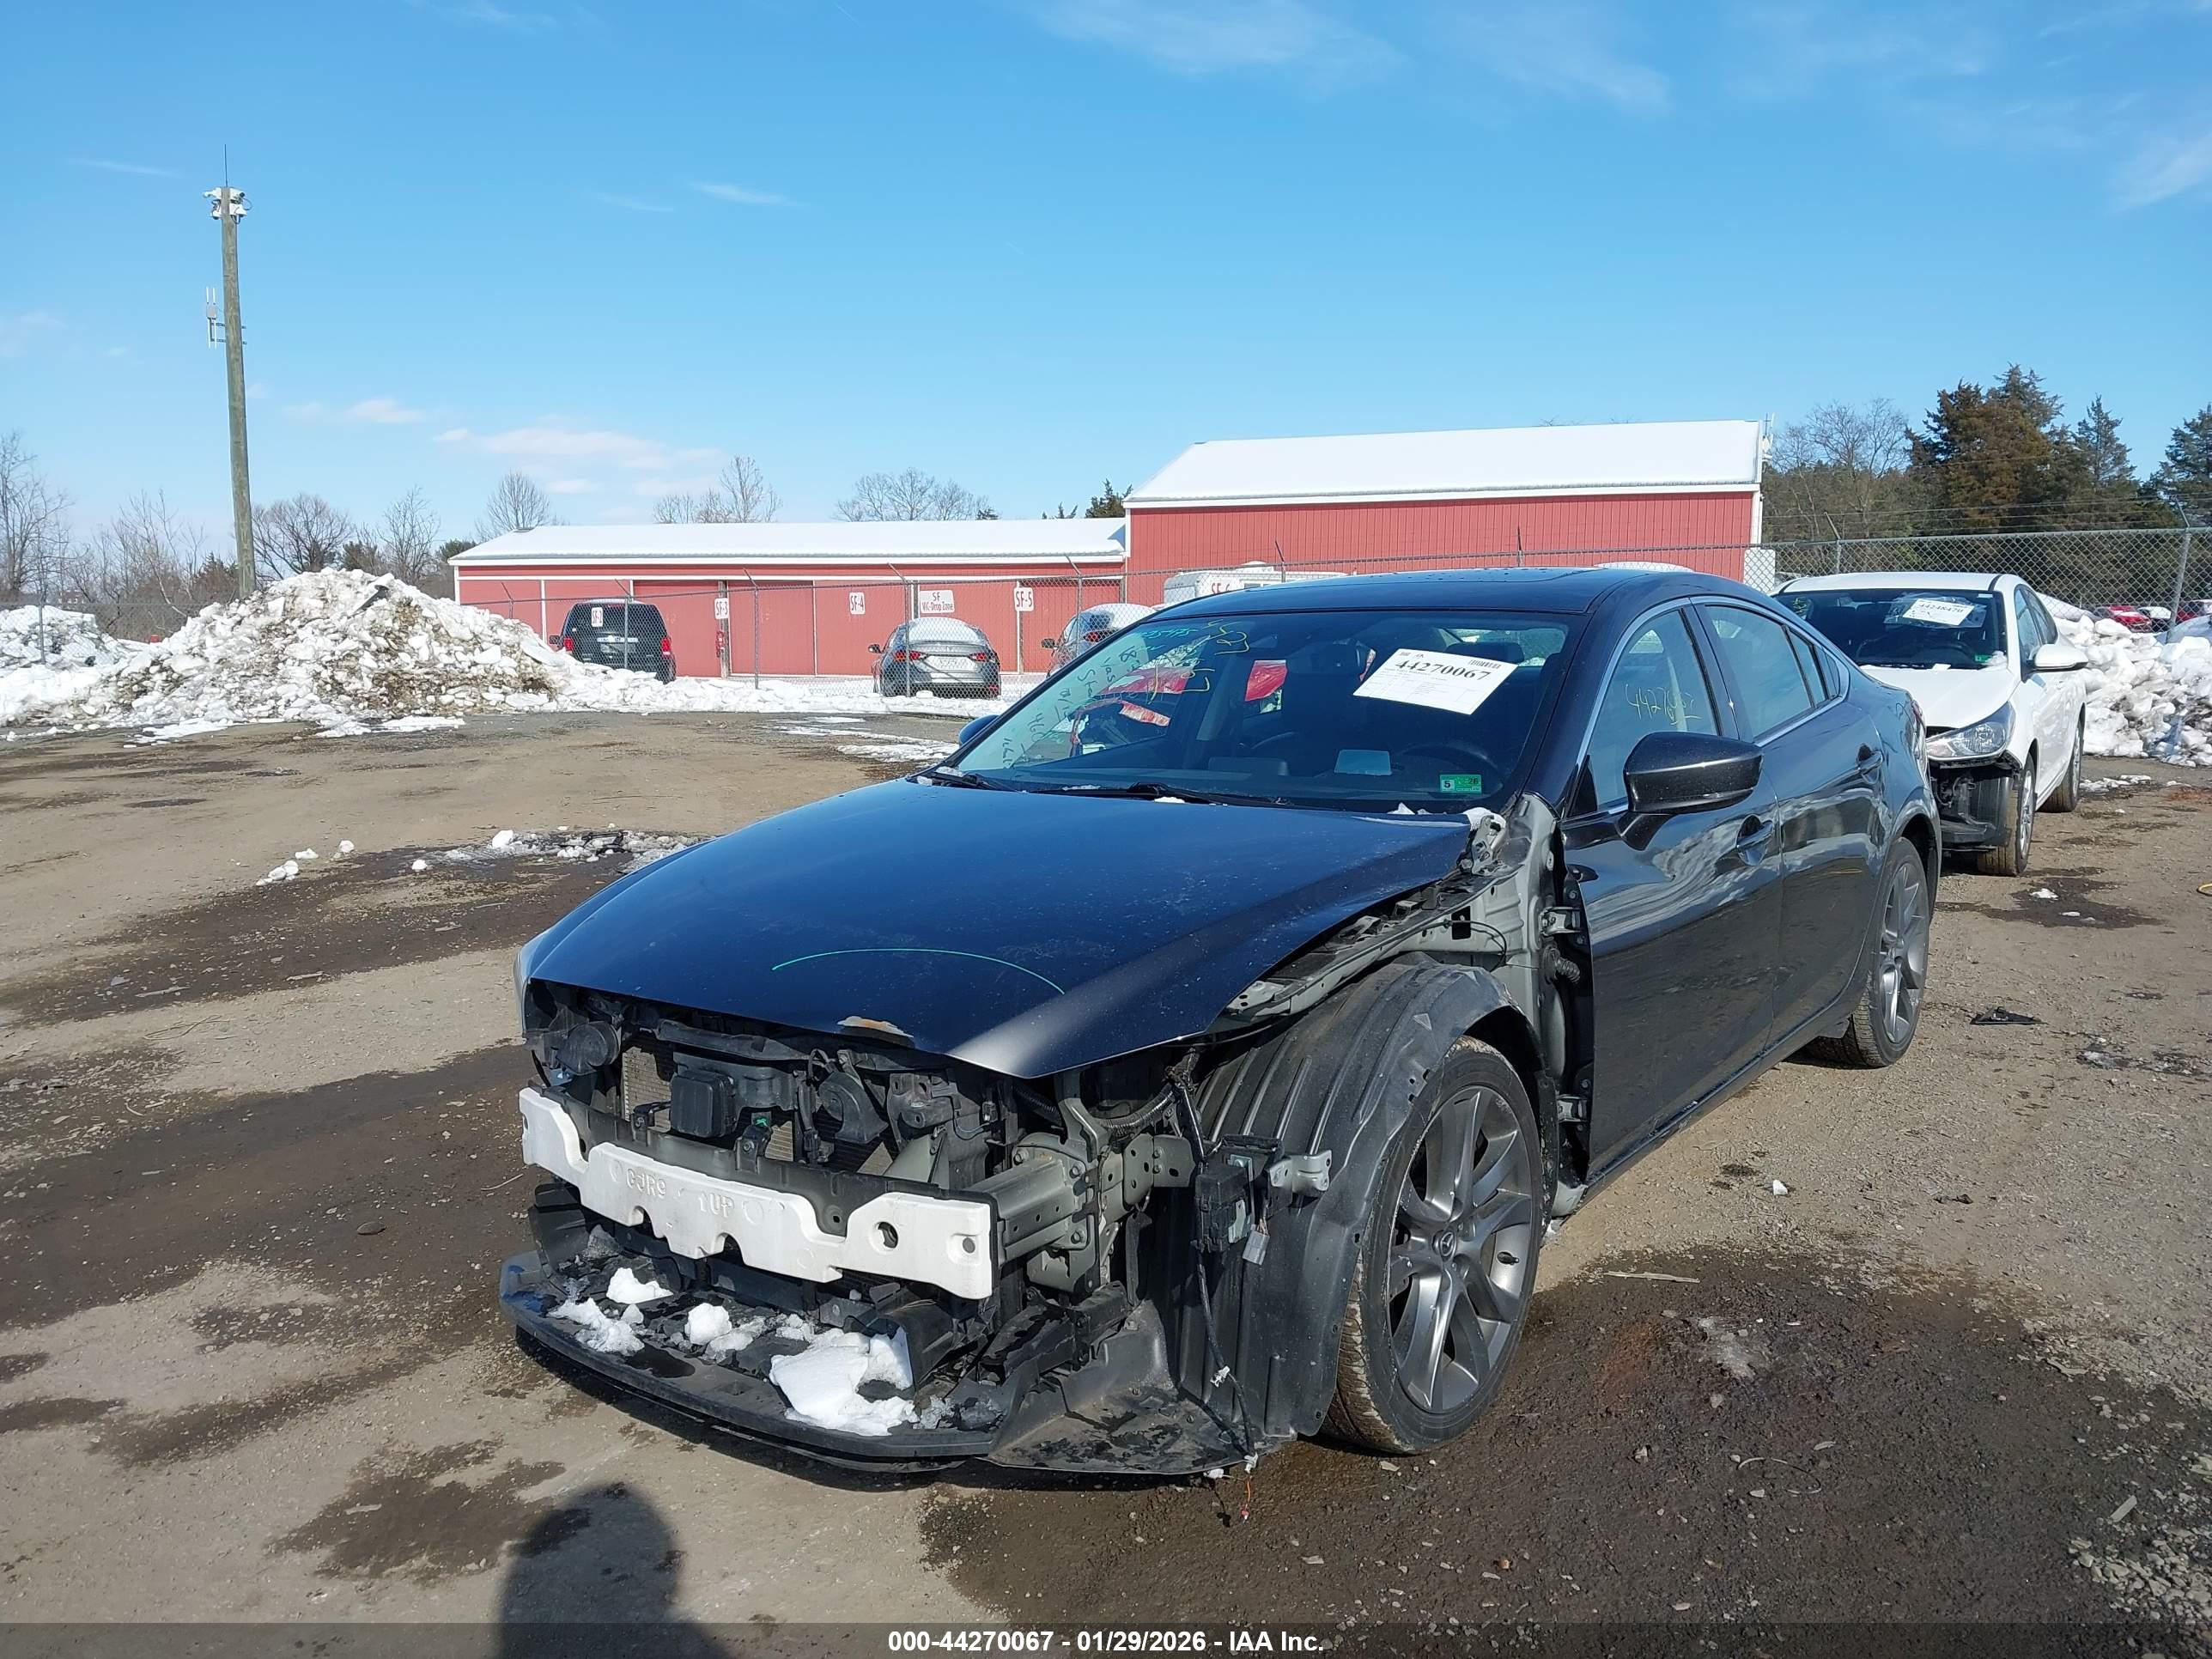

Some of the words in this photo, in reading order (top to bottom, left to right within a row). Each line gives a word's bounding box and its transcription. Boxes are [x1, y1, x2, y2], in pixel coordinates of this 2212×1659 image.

[850, 594, 865, 611] SF-4
[932, 592, 941, 602] SF
[1015, 590, 1033, 608] SF-5
[1395, 659, 1492, 681] 44270067
[1443, 780, 1451, 789] 5
